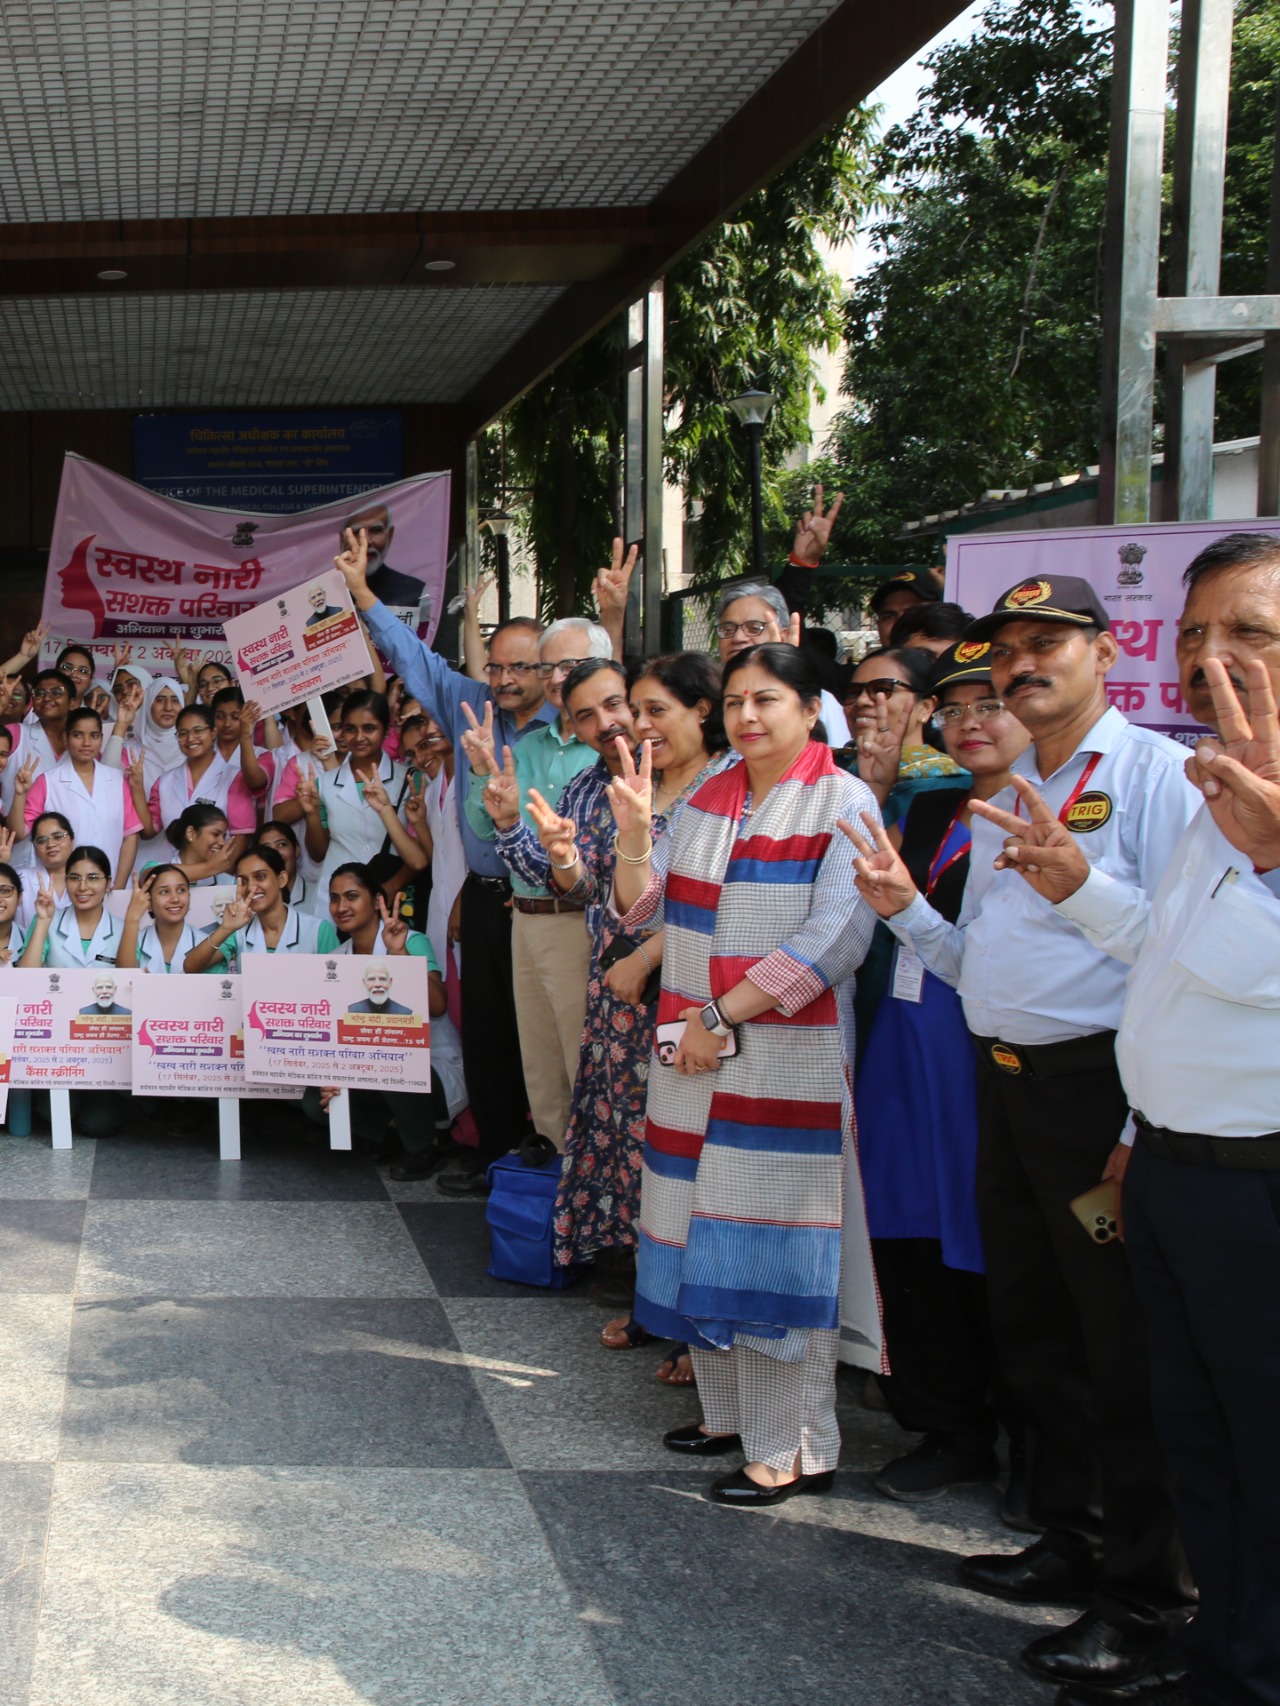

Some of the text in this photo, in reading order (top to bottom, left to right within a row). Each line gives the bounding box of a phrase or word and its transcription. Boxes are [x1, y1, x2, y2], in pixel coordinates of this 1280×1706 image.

[190, 426, 346, 441] चिकित्सा अधीक्षक का कार्यालय
[186, 483, 284, 497] OF THE MEDICAL
[95, 547, 265, 590] स्वस्थ नारी
[105, 590, 175, 616] सशक्त
[1103, 594, 1153, 602] भारत सरकार
[116, 622, 186, 634] अभियान का
[241, 638, 268, 657] स्वस्थ
[268, 625, 289, 643] नारी
[45, 642, 146, 659] 17 2
[249, 651, 269, 665] सशक्त
[269, 640, 293, 656] परिवार
[290, 675, 322, 694] टीकाकरण
[1071, 804, 1103, 817] TRIG
[24, 1000, 53, 1015] नारी
[258, 999, 331, 1016] स्वस्थ नारी
[20, 1016, 53, 1027] परिवार
[149, 1016, 224, 1032] स्वस्थ नारी
[265, 1016, 332, 1029] सशक्त परिवार
[156, 1032, 224, 1045] सशक्त परिवार
[29, 1046, 56, 1054] सशक्त
[59, 1043, 84, 1054] परिवार
[288, 1046, 305, 1056] नारी
[308, 1048, 336, 1058] सशक्त
[339, 1048, 365, 1059] परिवार
[179, 1060, 228, 1071] नारी सशक्त
